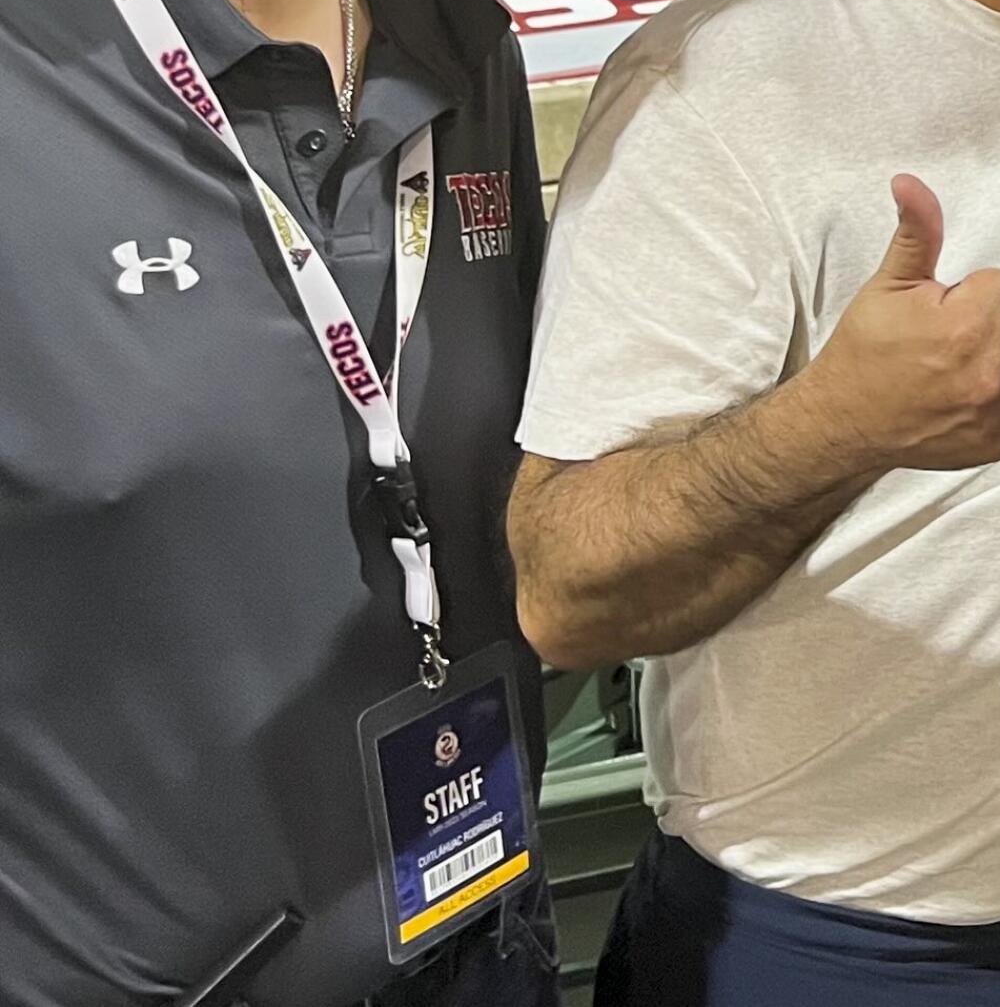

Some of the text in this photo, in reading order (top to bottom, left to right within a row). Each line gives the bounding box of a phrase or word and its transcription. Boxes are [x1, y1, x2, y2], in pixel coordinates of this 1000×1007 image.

[160, 47, 225, 135] TECOS
[326, 320, 382, 407] TECOS
[424, 766, 484, 825] STAFF
